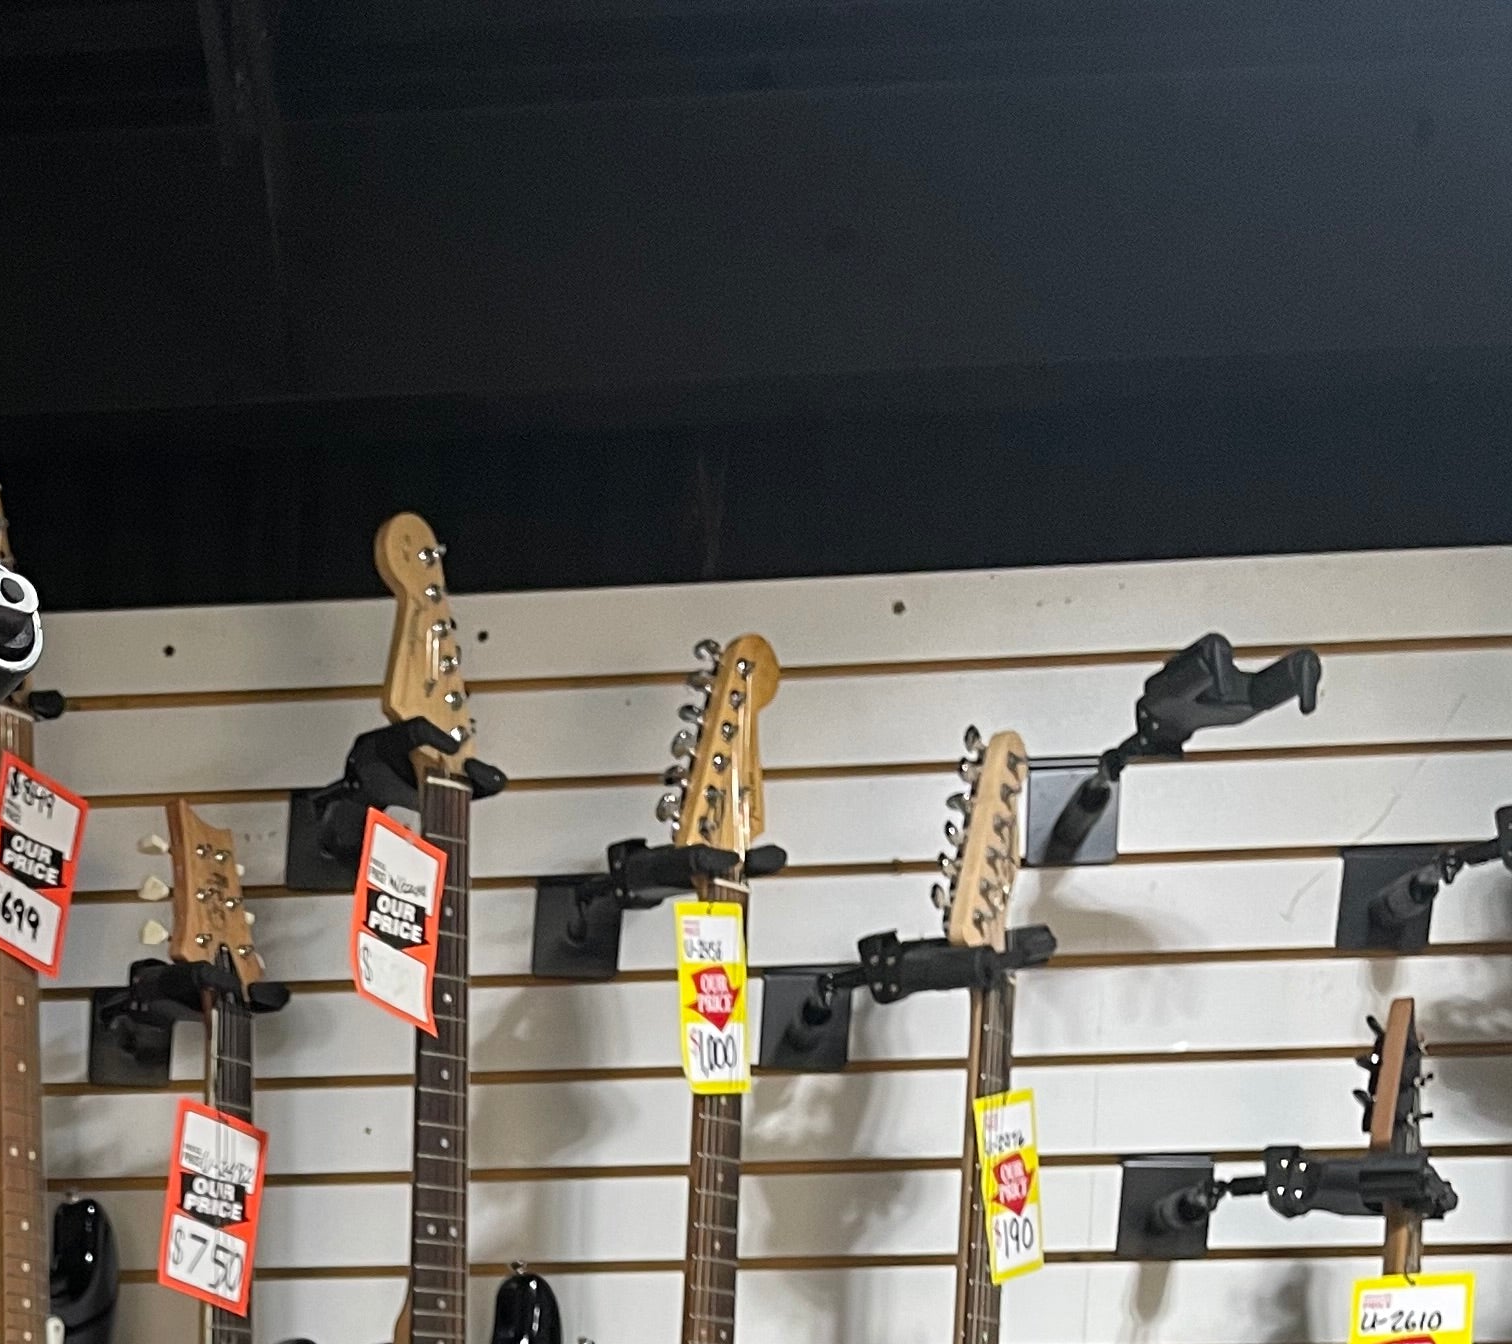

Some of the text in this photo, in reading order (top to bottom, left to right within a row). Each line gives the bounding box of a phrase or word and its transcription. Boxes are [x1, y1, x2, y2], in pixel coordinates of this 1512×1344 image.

[10, 834, 54, 863] OUR
[2, 848, 60, 887] PRICE
[375, 893, 417, 923] OUR
[367, 910, 424, 944] PRICE
[699, 972, 729, 993] OUR
[696, 992, 733, 1014] PRICE
[191, 1176, 236, 1202] OUR
[182, 1192, 244, 1222] PRICE
